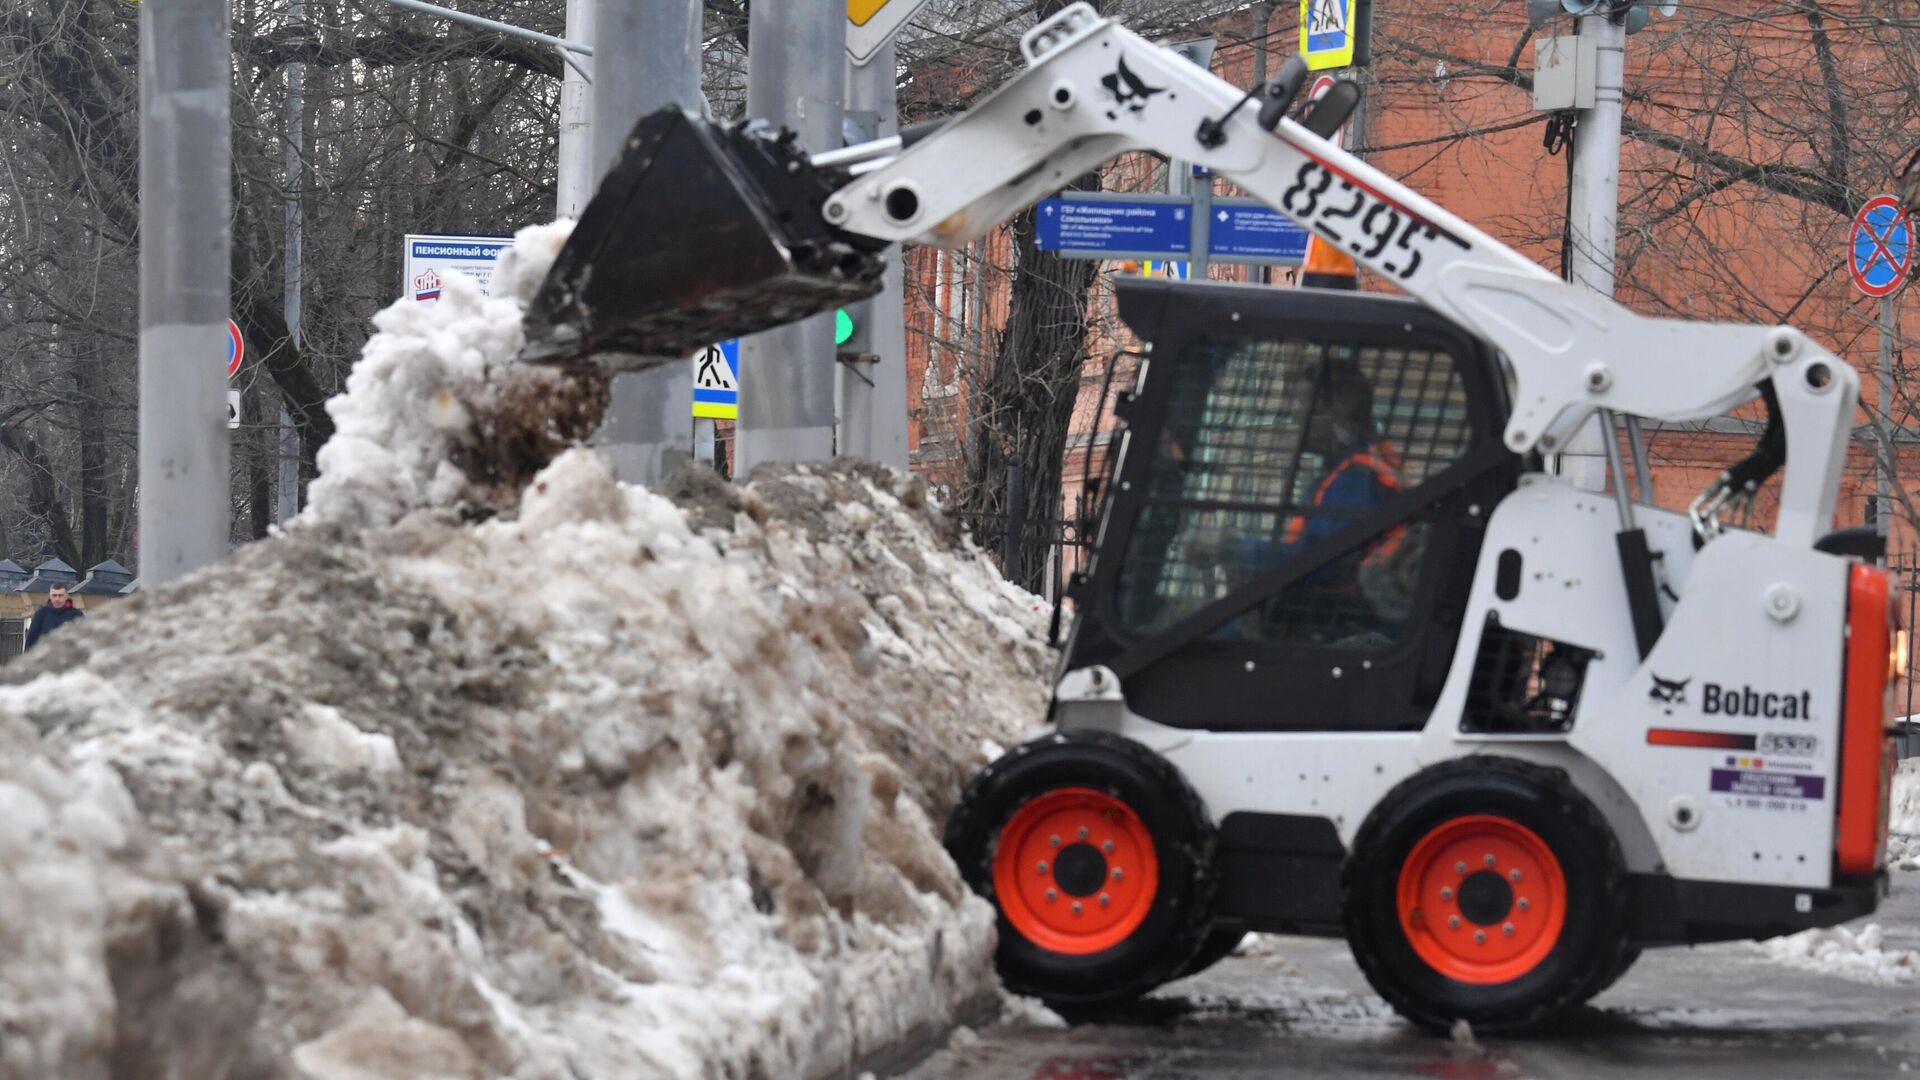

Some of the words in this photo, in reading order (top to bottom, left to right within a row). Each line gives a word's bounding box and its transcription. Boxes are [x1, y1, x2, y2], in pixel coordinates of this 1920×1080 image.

[1283, 160, 1437, 279] 8295
[415, 246, 481, 256] ПЕНСИОННЫЙ
[1703, 684, 1811, 720] Bobcat
